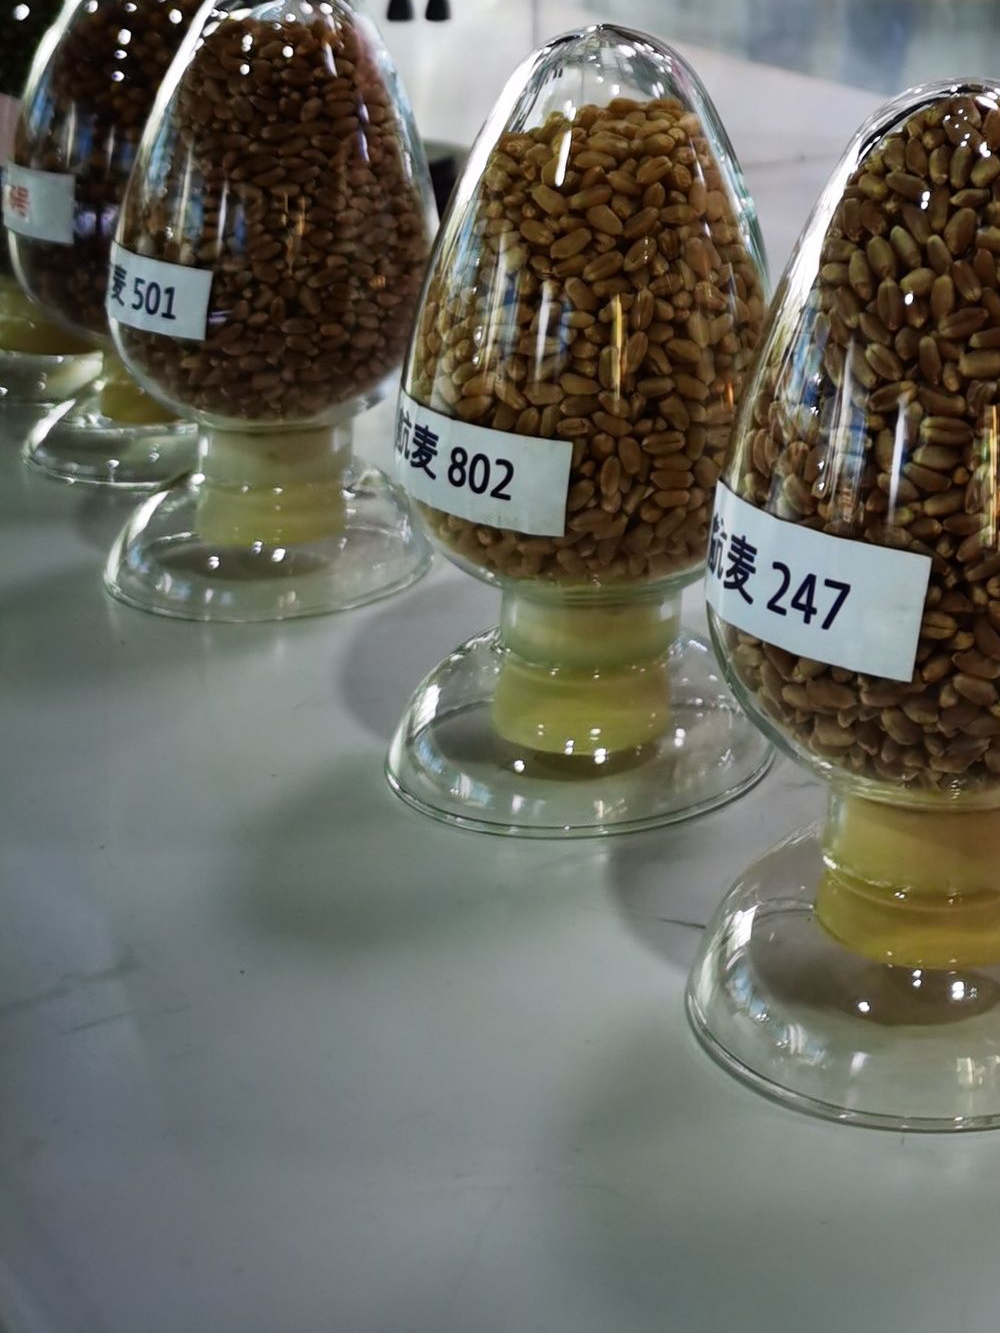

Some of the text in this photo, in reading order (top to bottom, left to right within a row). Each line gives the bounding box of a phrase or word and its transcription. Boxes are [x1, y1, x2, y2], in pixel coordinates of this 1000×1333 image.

[131, 276, 177, 321] 501
[447, 446, 515, 502] 802
[766, 561, 852, 631] 247
